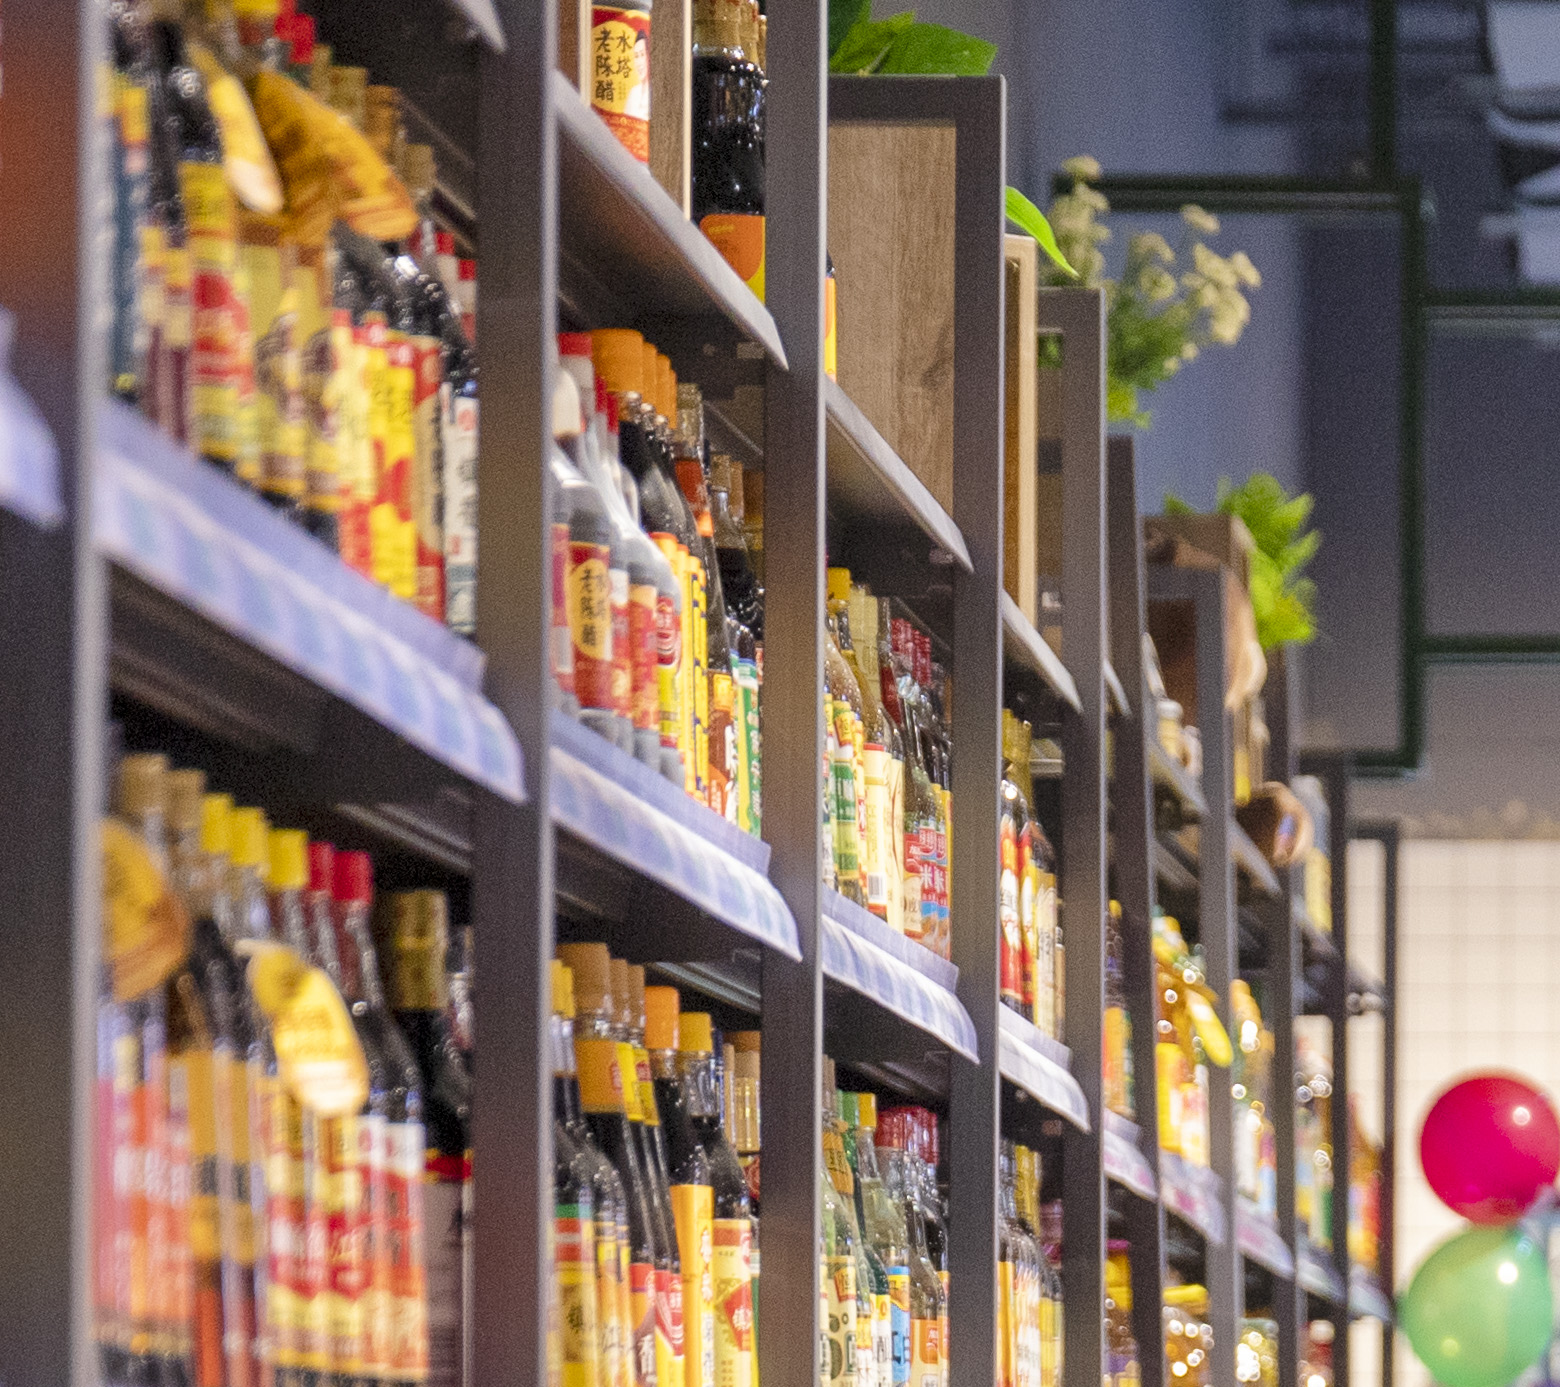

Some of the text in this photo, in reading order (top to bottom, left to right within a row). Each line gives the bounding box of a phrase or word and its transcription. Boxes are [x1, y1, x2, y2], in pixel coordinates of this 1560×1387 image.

[593, 28, 617, 104] 老陈醋
[615, 33, 634, 81] 水塔
